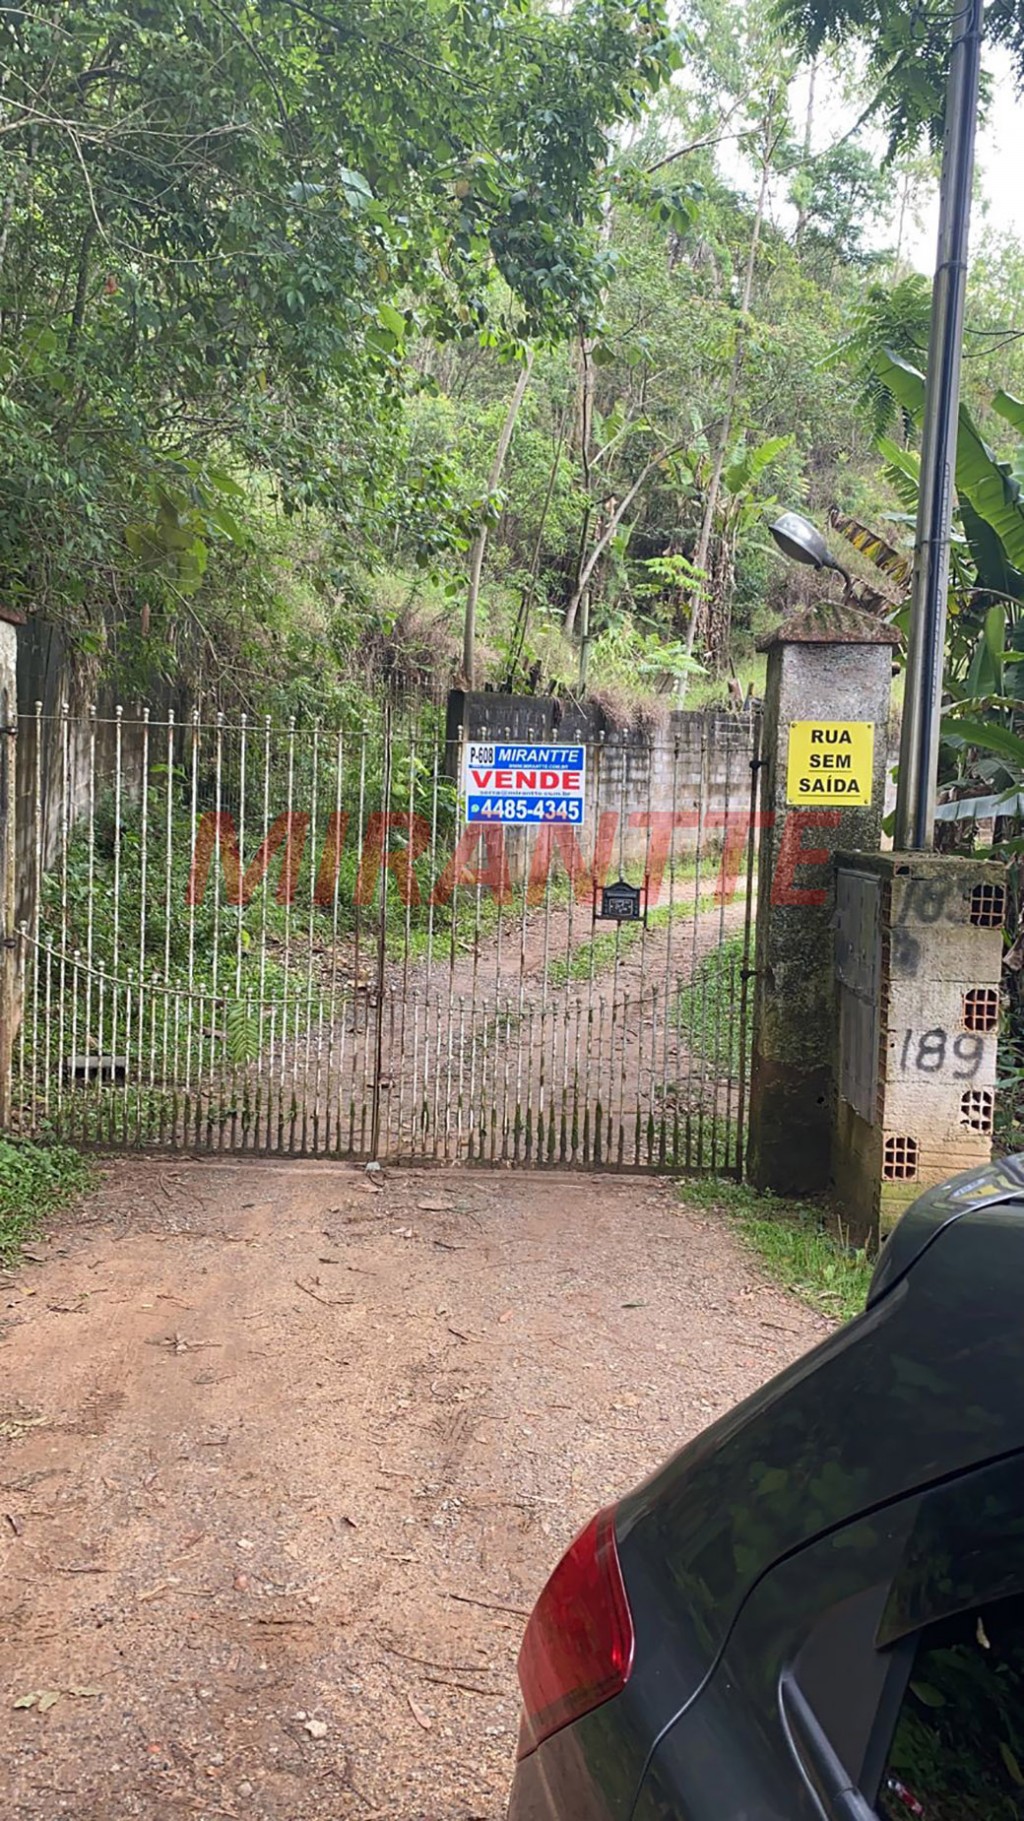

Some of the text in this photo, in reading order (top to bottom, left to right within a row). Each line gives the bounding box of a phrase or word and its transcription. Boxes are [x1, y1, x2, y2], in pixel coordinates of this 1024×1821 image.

[811, 730, 852, 744] RUA
[498, 748, 579, 763] MIRANTTE
[809, 754, 851, 768] SEM
[472, 770, 580, 790] VENDE
[799, 775, 860, 793] SAÍDA
[481, 799, 580, 820] 4485-4345
[899, 1027, 985, 1080] 189
